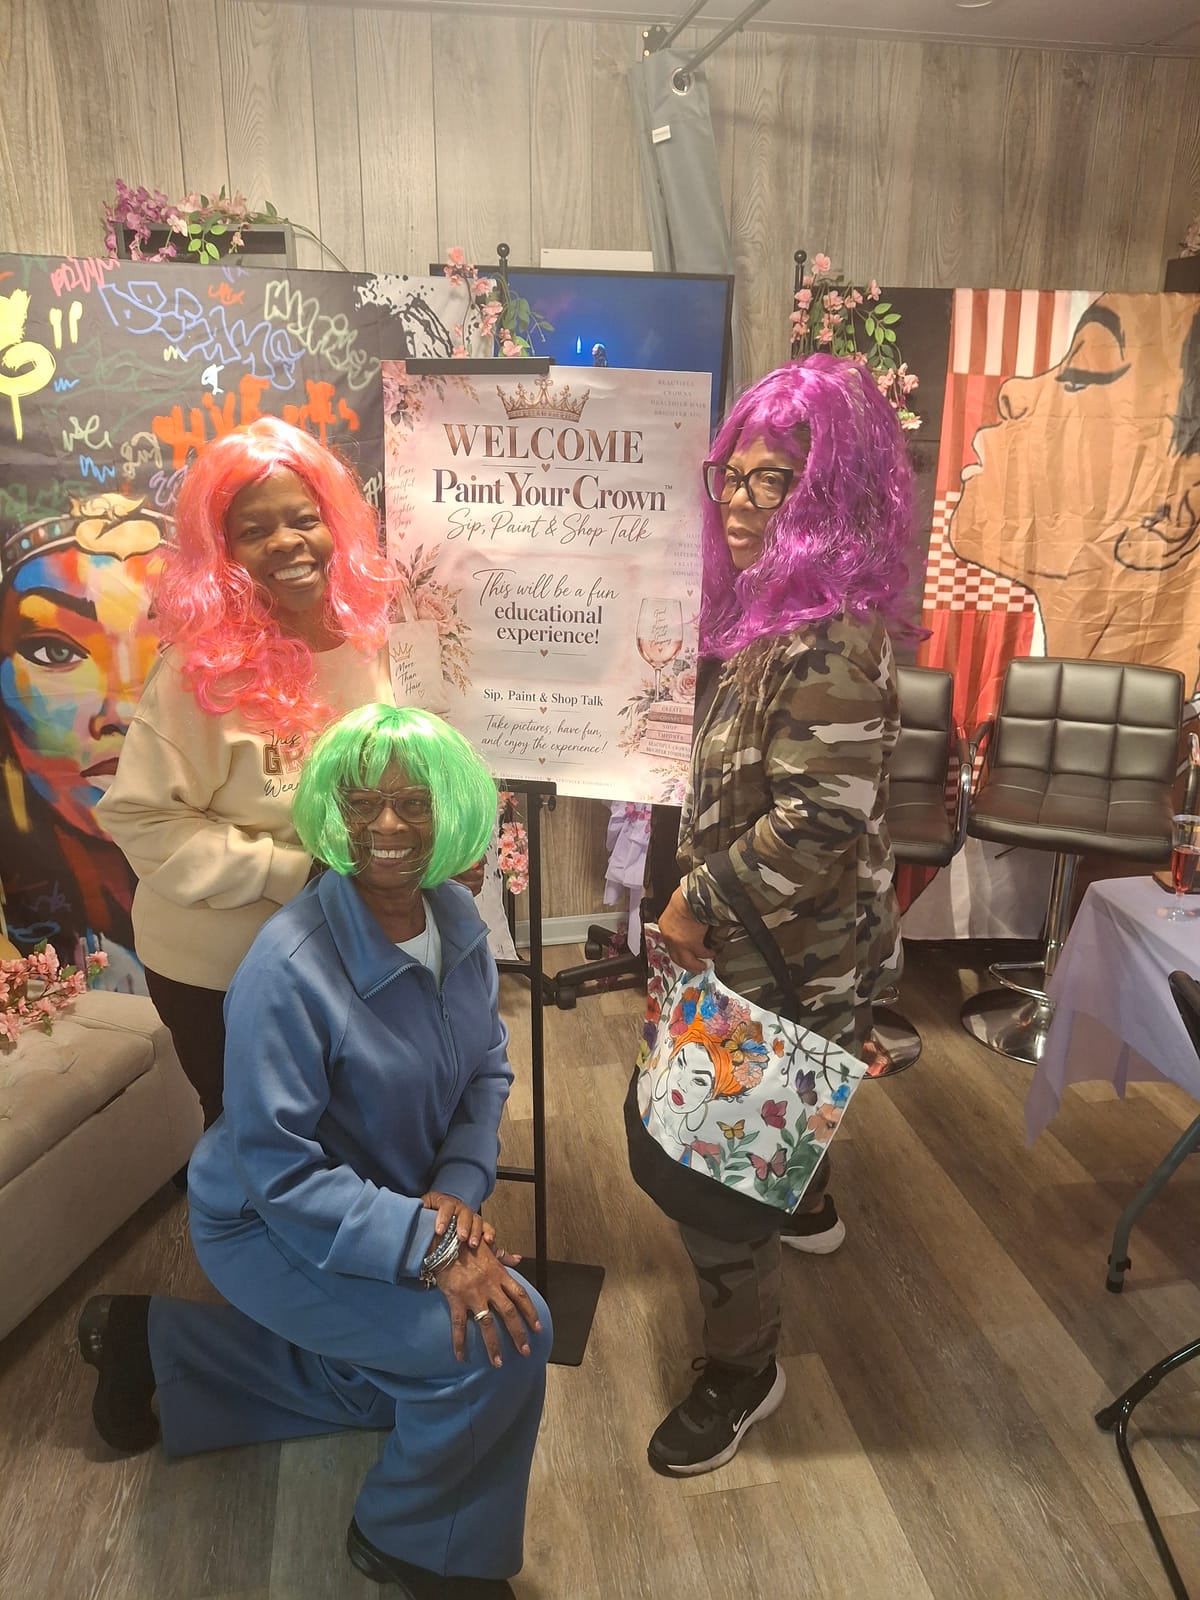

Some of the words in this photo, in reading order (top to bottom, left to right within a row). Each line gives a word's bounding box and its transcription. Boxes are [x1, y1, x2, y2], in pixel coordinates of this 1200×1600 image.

[443, 423, 644, 464] WELCOME
[432, 468, 505, 504] Paint
[504, 471, 571, 507] Your
[446, 508, 486, 541] Sip,
[490, 510, 543, 540] Paint
[544, 516, 558, 536] &
[559, 512, 606, 545] Shop
[608, 514, 652, 545] Talk
[472, 568, 516, 606] This
[516, 573, 554, 599] will
[553, 574, 571, 598] be
[574, 588, 585, 598] a
[586, 577, 620, 607] fun
[494, 601, 603, 625] educational
[496, 625, 600, 645] experience!
[483, 688, 504, 702] Sip,
[508, 690, 536, 703] Paint
[539, 692, 548, 703] &
[551, 692, 578, 707] Shop
[580, 694, 604, 707] Talk
[485, 714, 509, 731] Take
[510, 719, 552, 736] pictures,
[557, 719, 581, 734] have
[580, 721, 602, 740] fun,
[481, 732, 504, 746] and
[503, 738, 532, 755] enjoy
[532, 736, 548, 750] the
[550, 741, 608, 757] experience!
